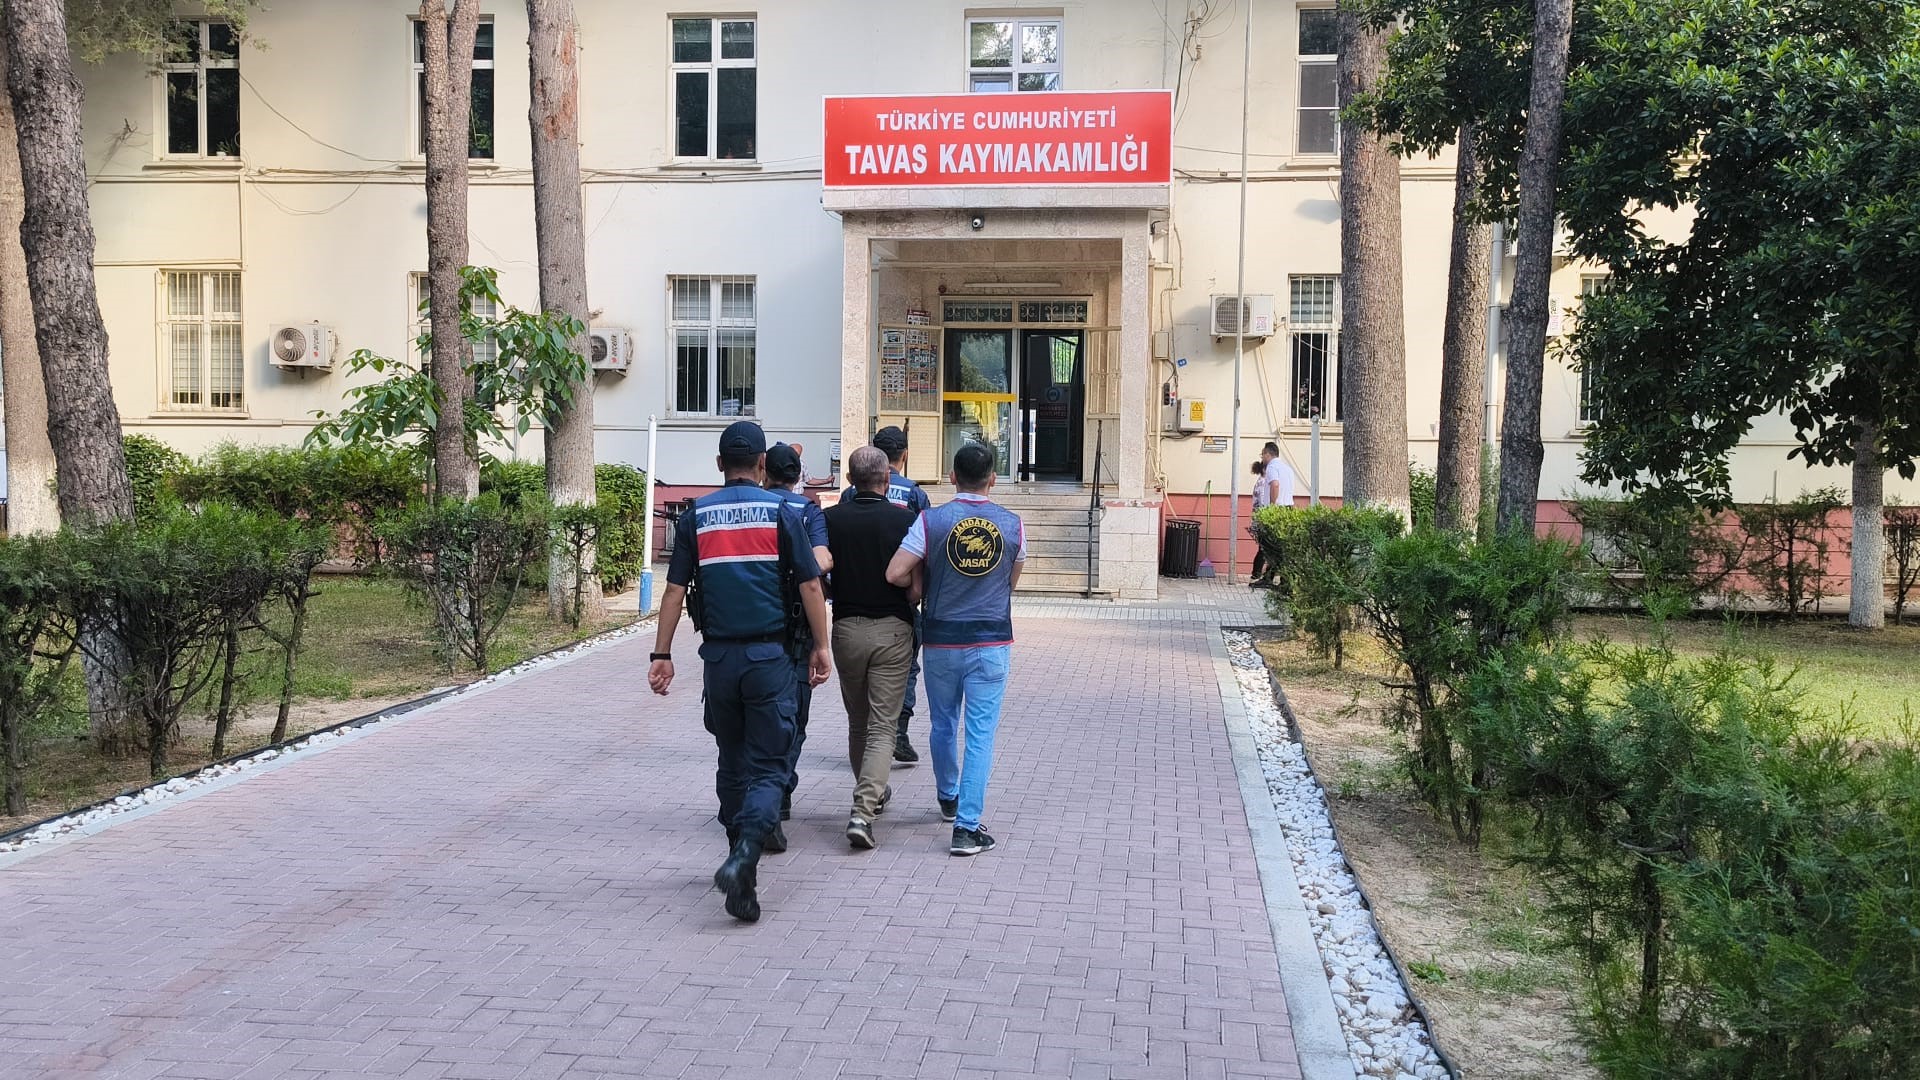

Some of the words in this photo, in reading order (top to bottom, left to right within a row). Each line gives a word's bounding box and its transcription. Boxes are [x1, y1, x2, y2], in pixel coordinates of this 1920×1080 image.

[876, 109, 965, 130] TÜRKİYE
[973, 106, 1116, 129] CUMHURİYETİ
[845, 143, 928, 174] TAVAS
[939, 134, 1148, 173] KAYMAKAMLIĞI
[702, 507, 769, 527] JANDARMA
[953, 519, 999, 537] JANDARMA
[959, 558, 991, 568] JASAT
